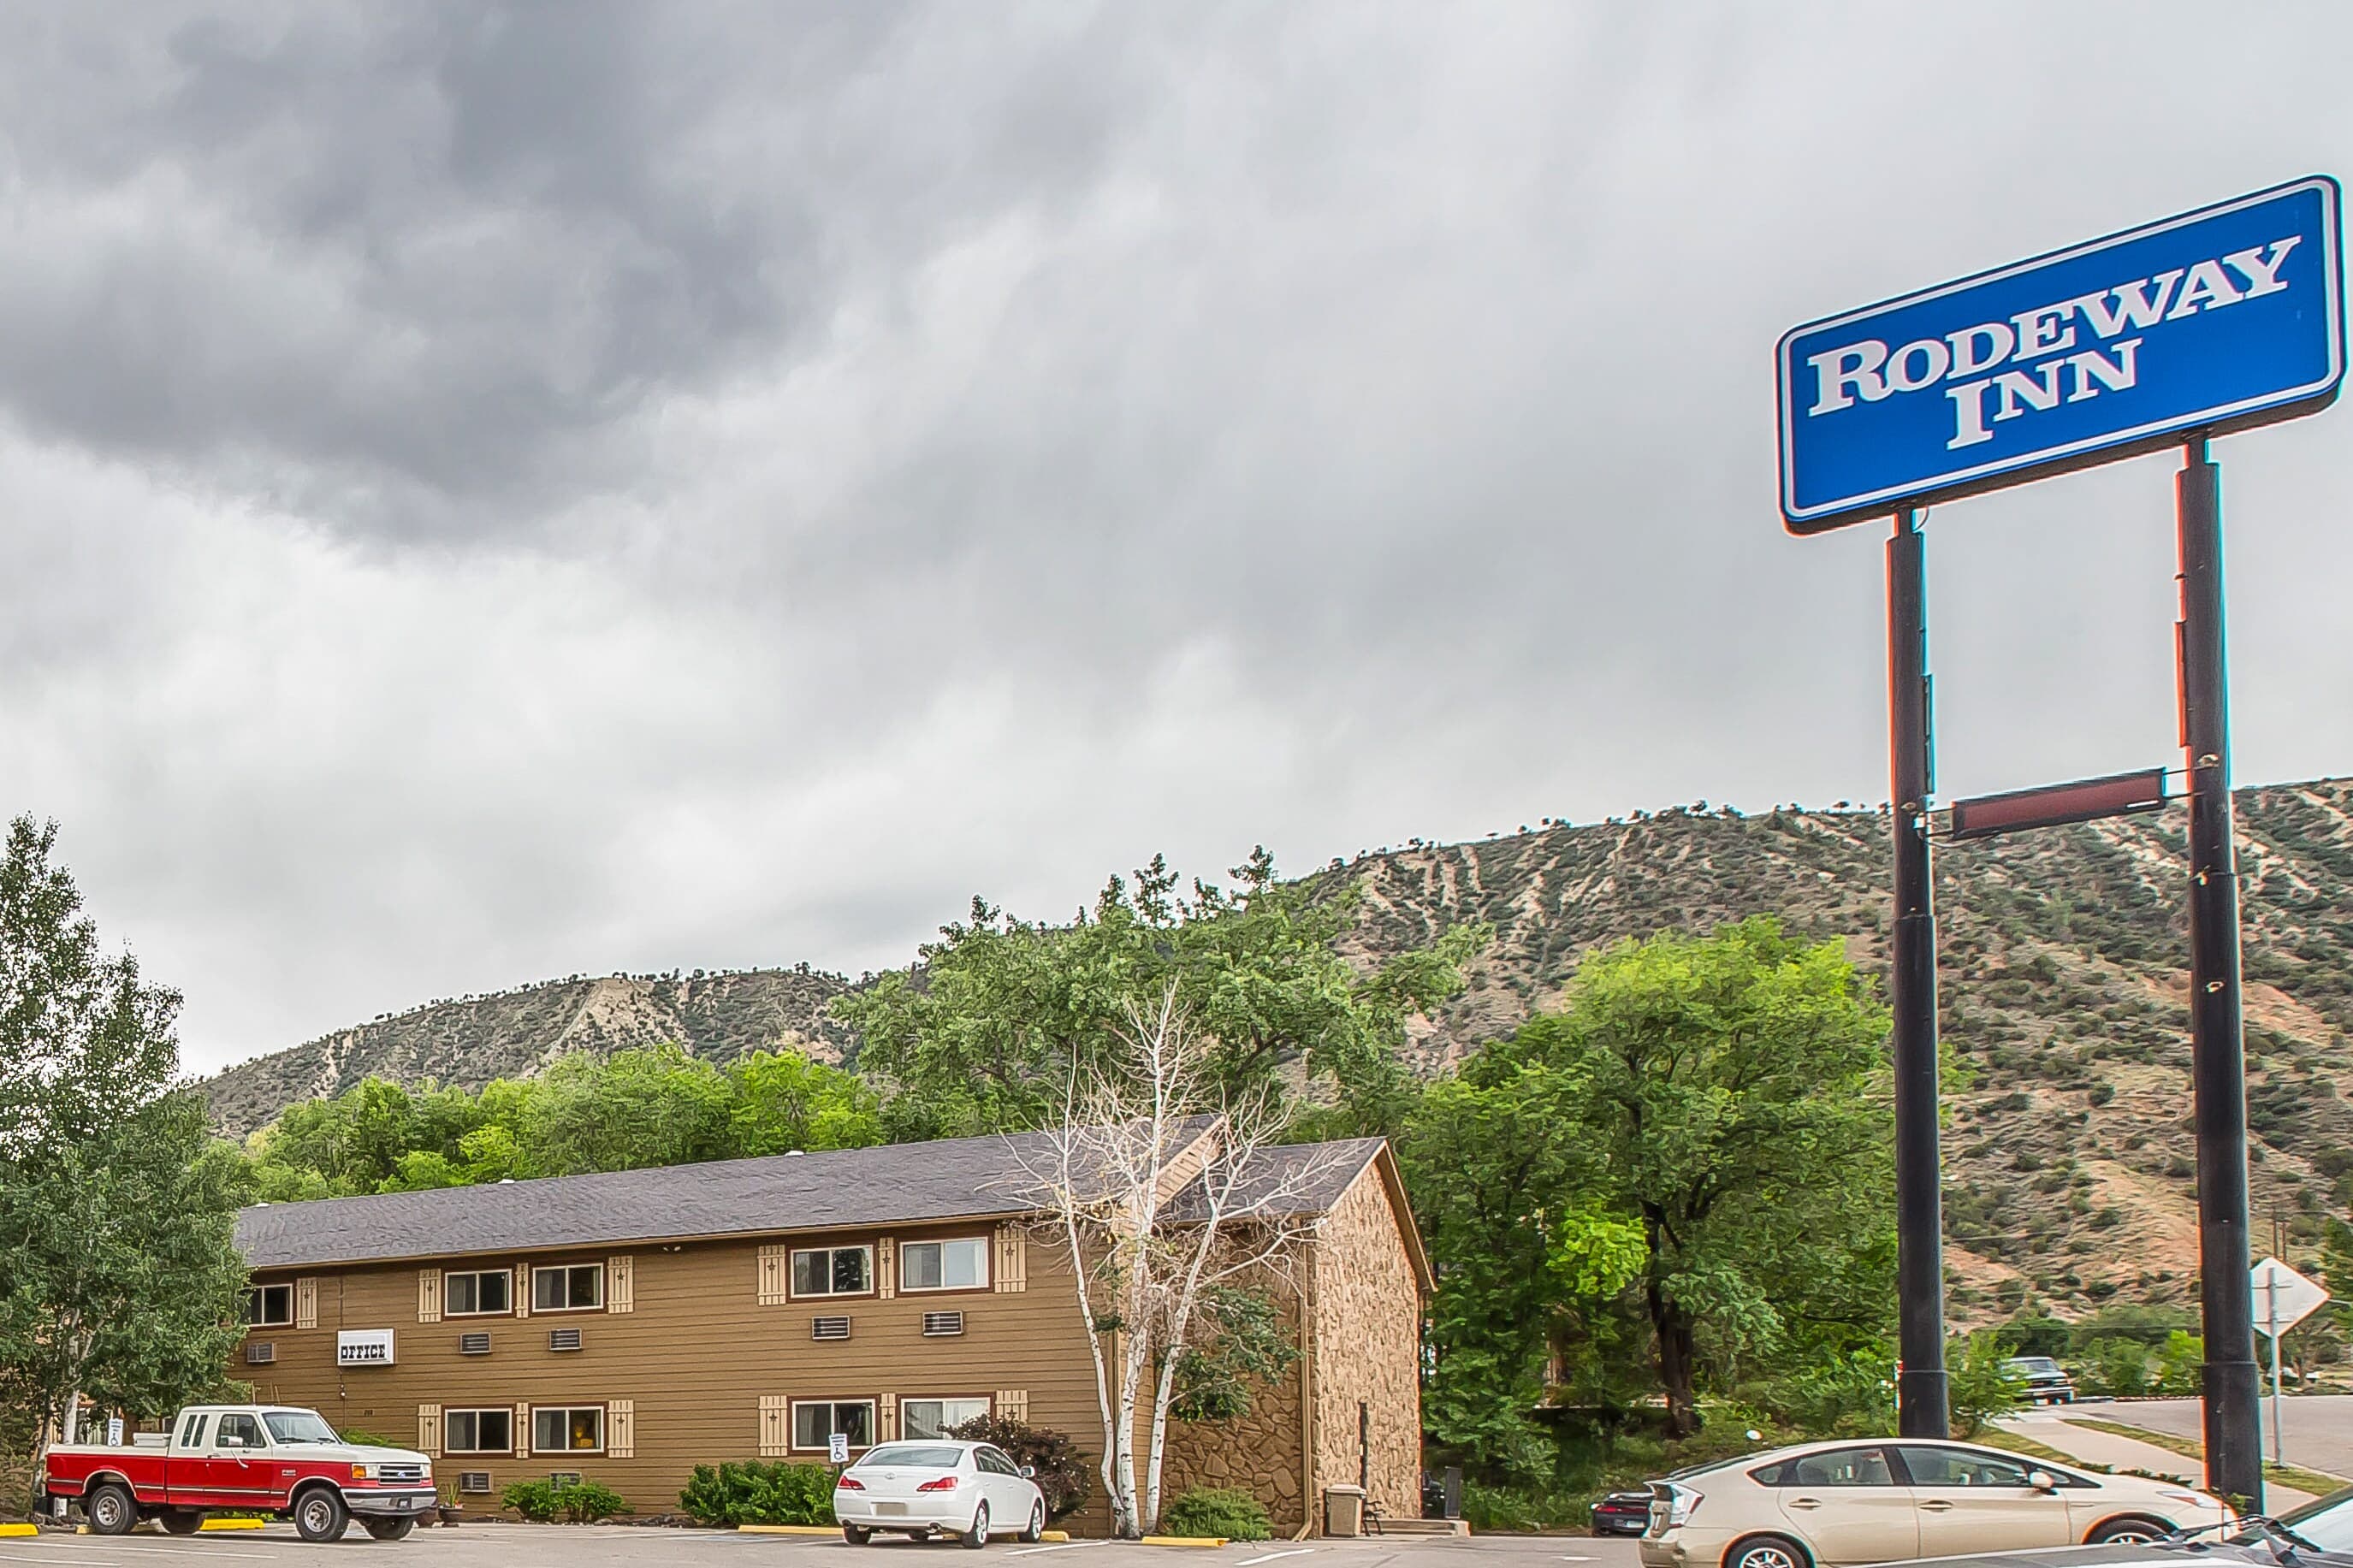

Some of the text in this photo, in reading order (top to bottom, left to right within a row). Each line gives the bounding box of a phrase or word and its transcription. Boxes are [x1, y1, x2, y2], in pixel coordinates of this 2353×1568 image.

[1807, 235, 2302, 417] RODEWAY
[1946, 337, 2143, 451] INN
[341, 1344, 385, 1359] OFFICE
